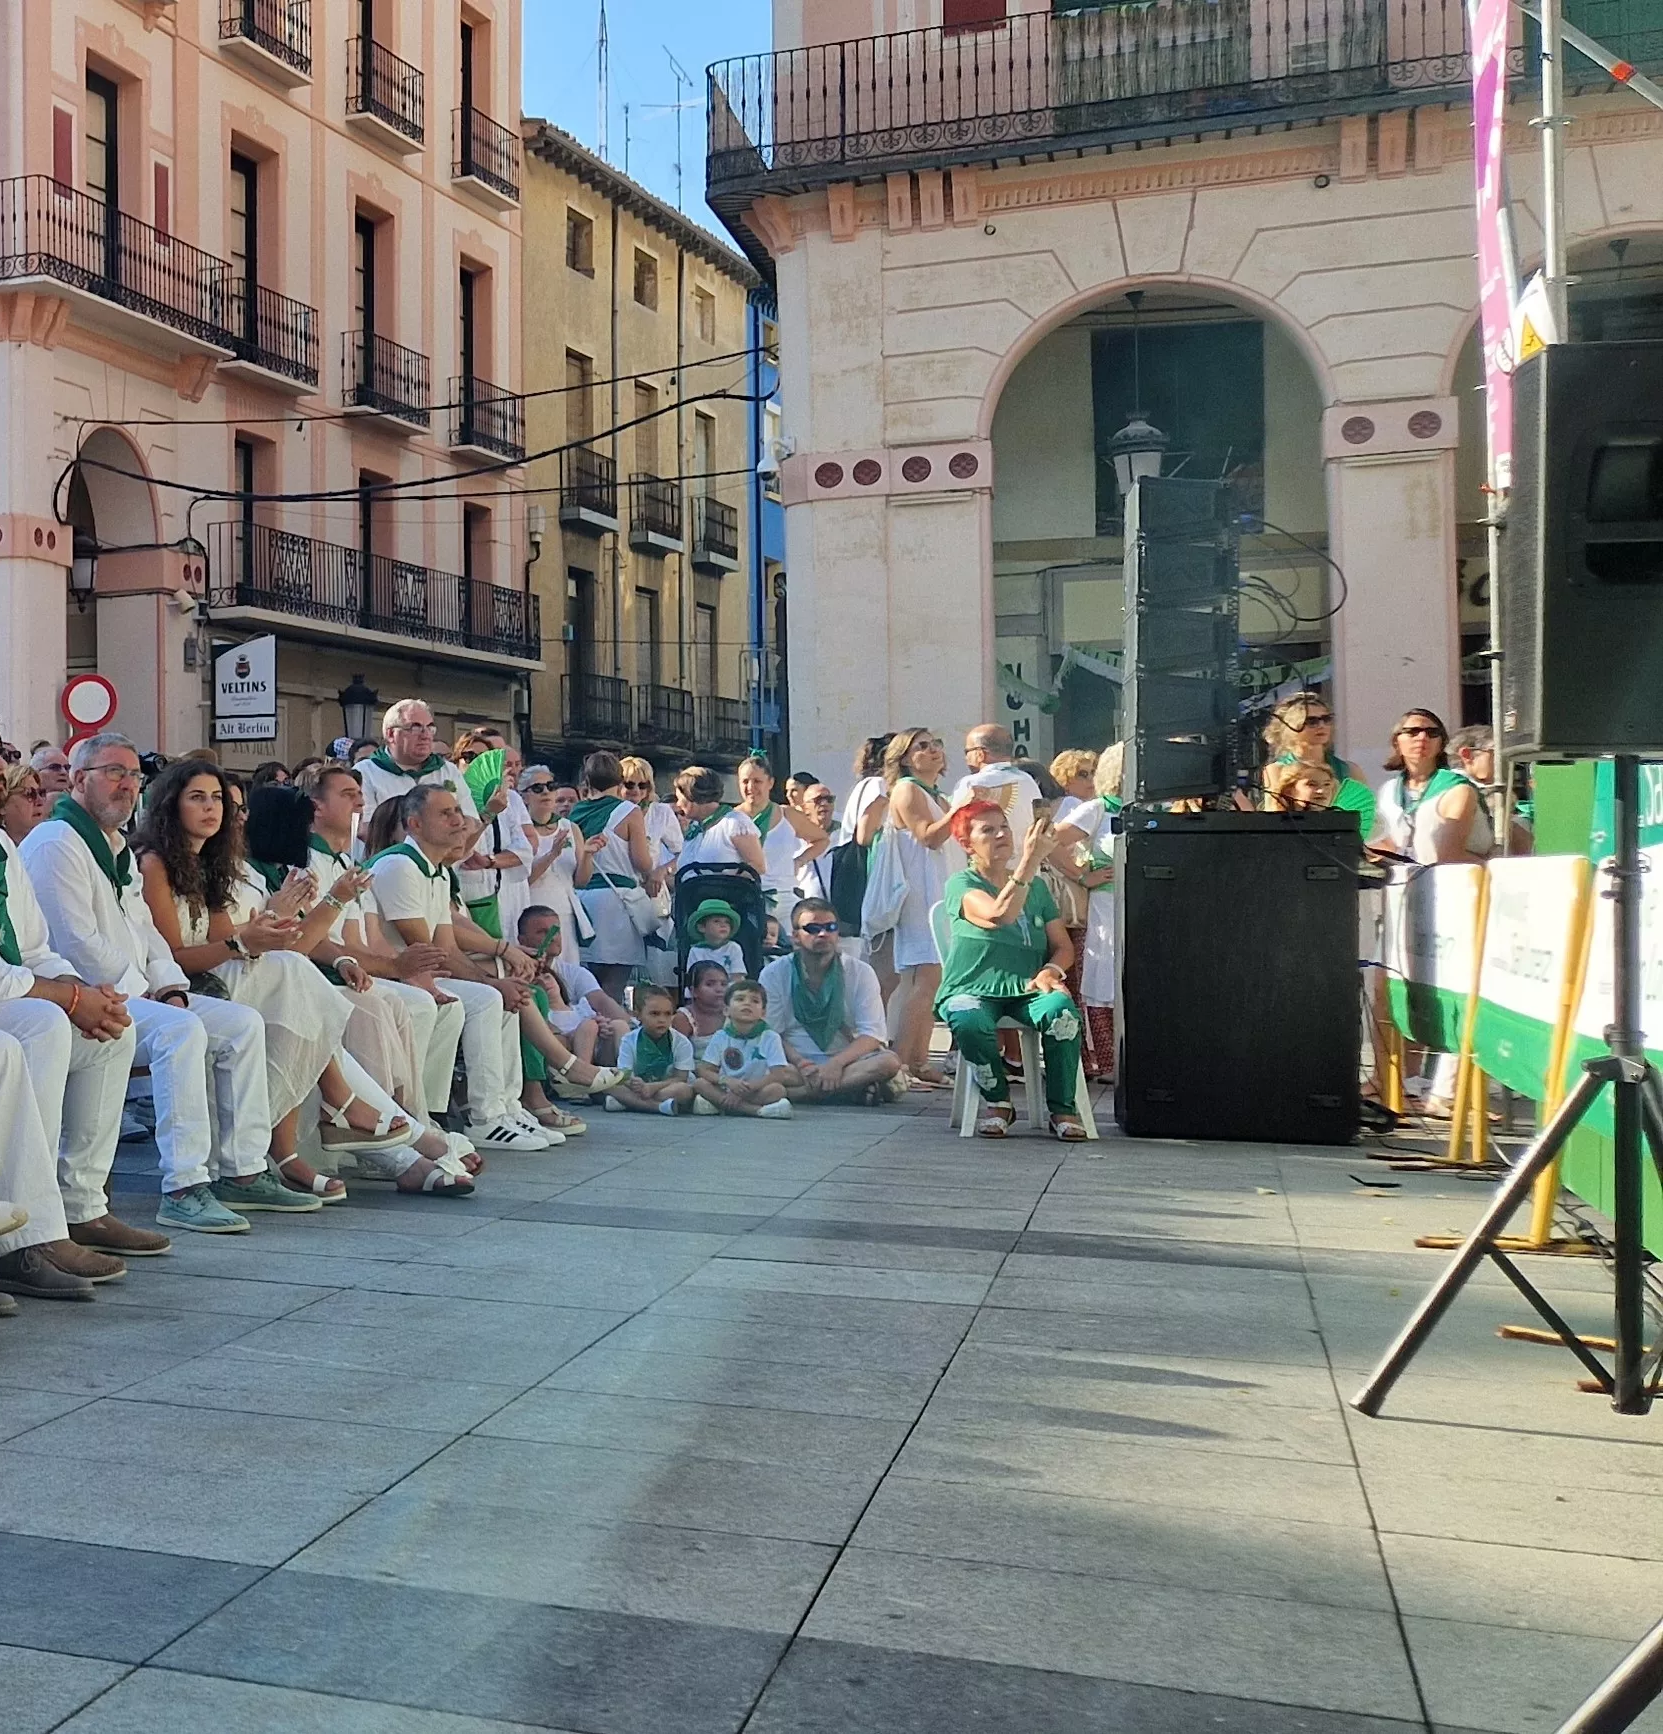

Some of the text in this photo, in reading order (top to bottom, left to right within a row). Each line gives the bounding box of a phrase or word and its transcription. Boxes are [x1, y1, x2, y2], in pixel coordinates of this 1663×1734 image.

[221, 681, 267, 694] VELTINS
[220, 722, 270, 735] Alt Berlin
